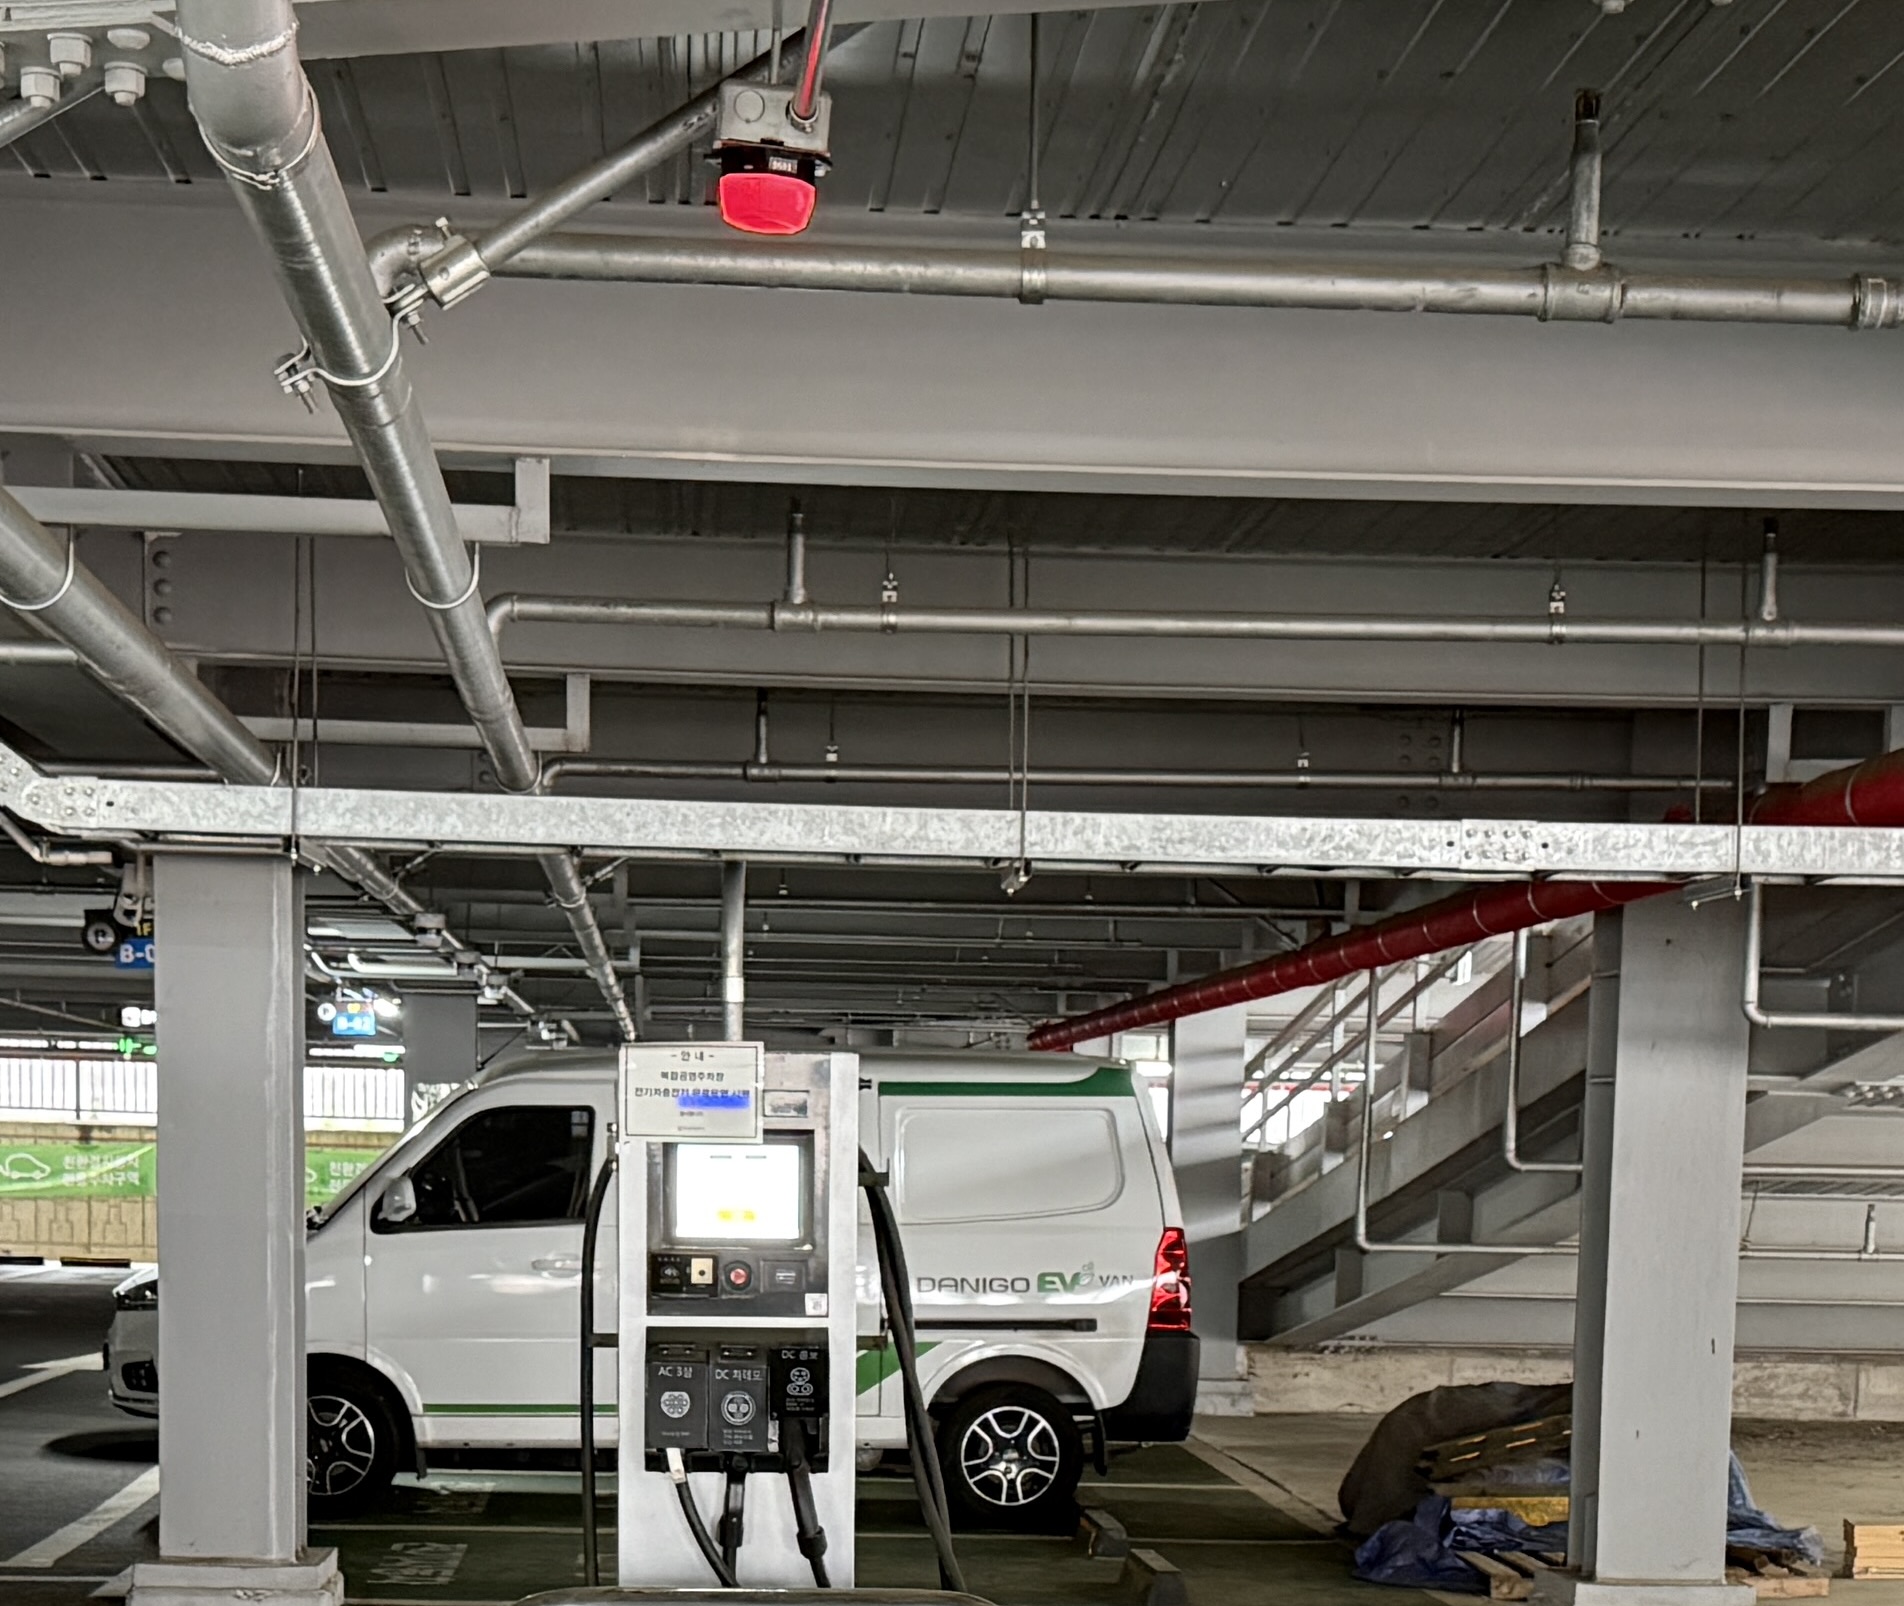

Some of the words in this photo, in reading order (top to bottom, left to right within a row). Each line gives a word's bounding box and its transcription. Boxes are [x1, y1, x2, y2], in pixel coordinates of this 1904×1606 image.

[916, 1276, 1031, 1293] DANIGO
[1037, 1271, 1082, 1293] EV
[1099, 1274, 1134, 1288] VAN
[781, 1350, 796, 1360] DC
[658, 1366, 674, 1377] AC
[715, 1369, 730, 1380] DC
